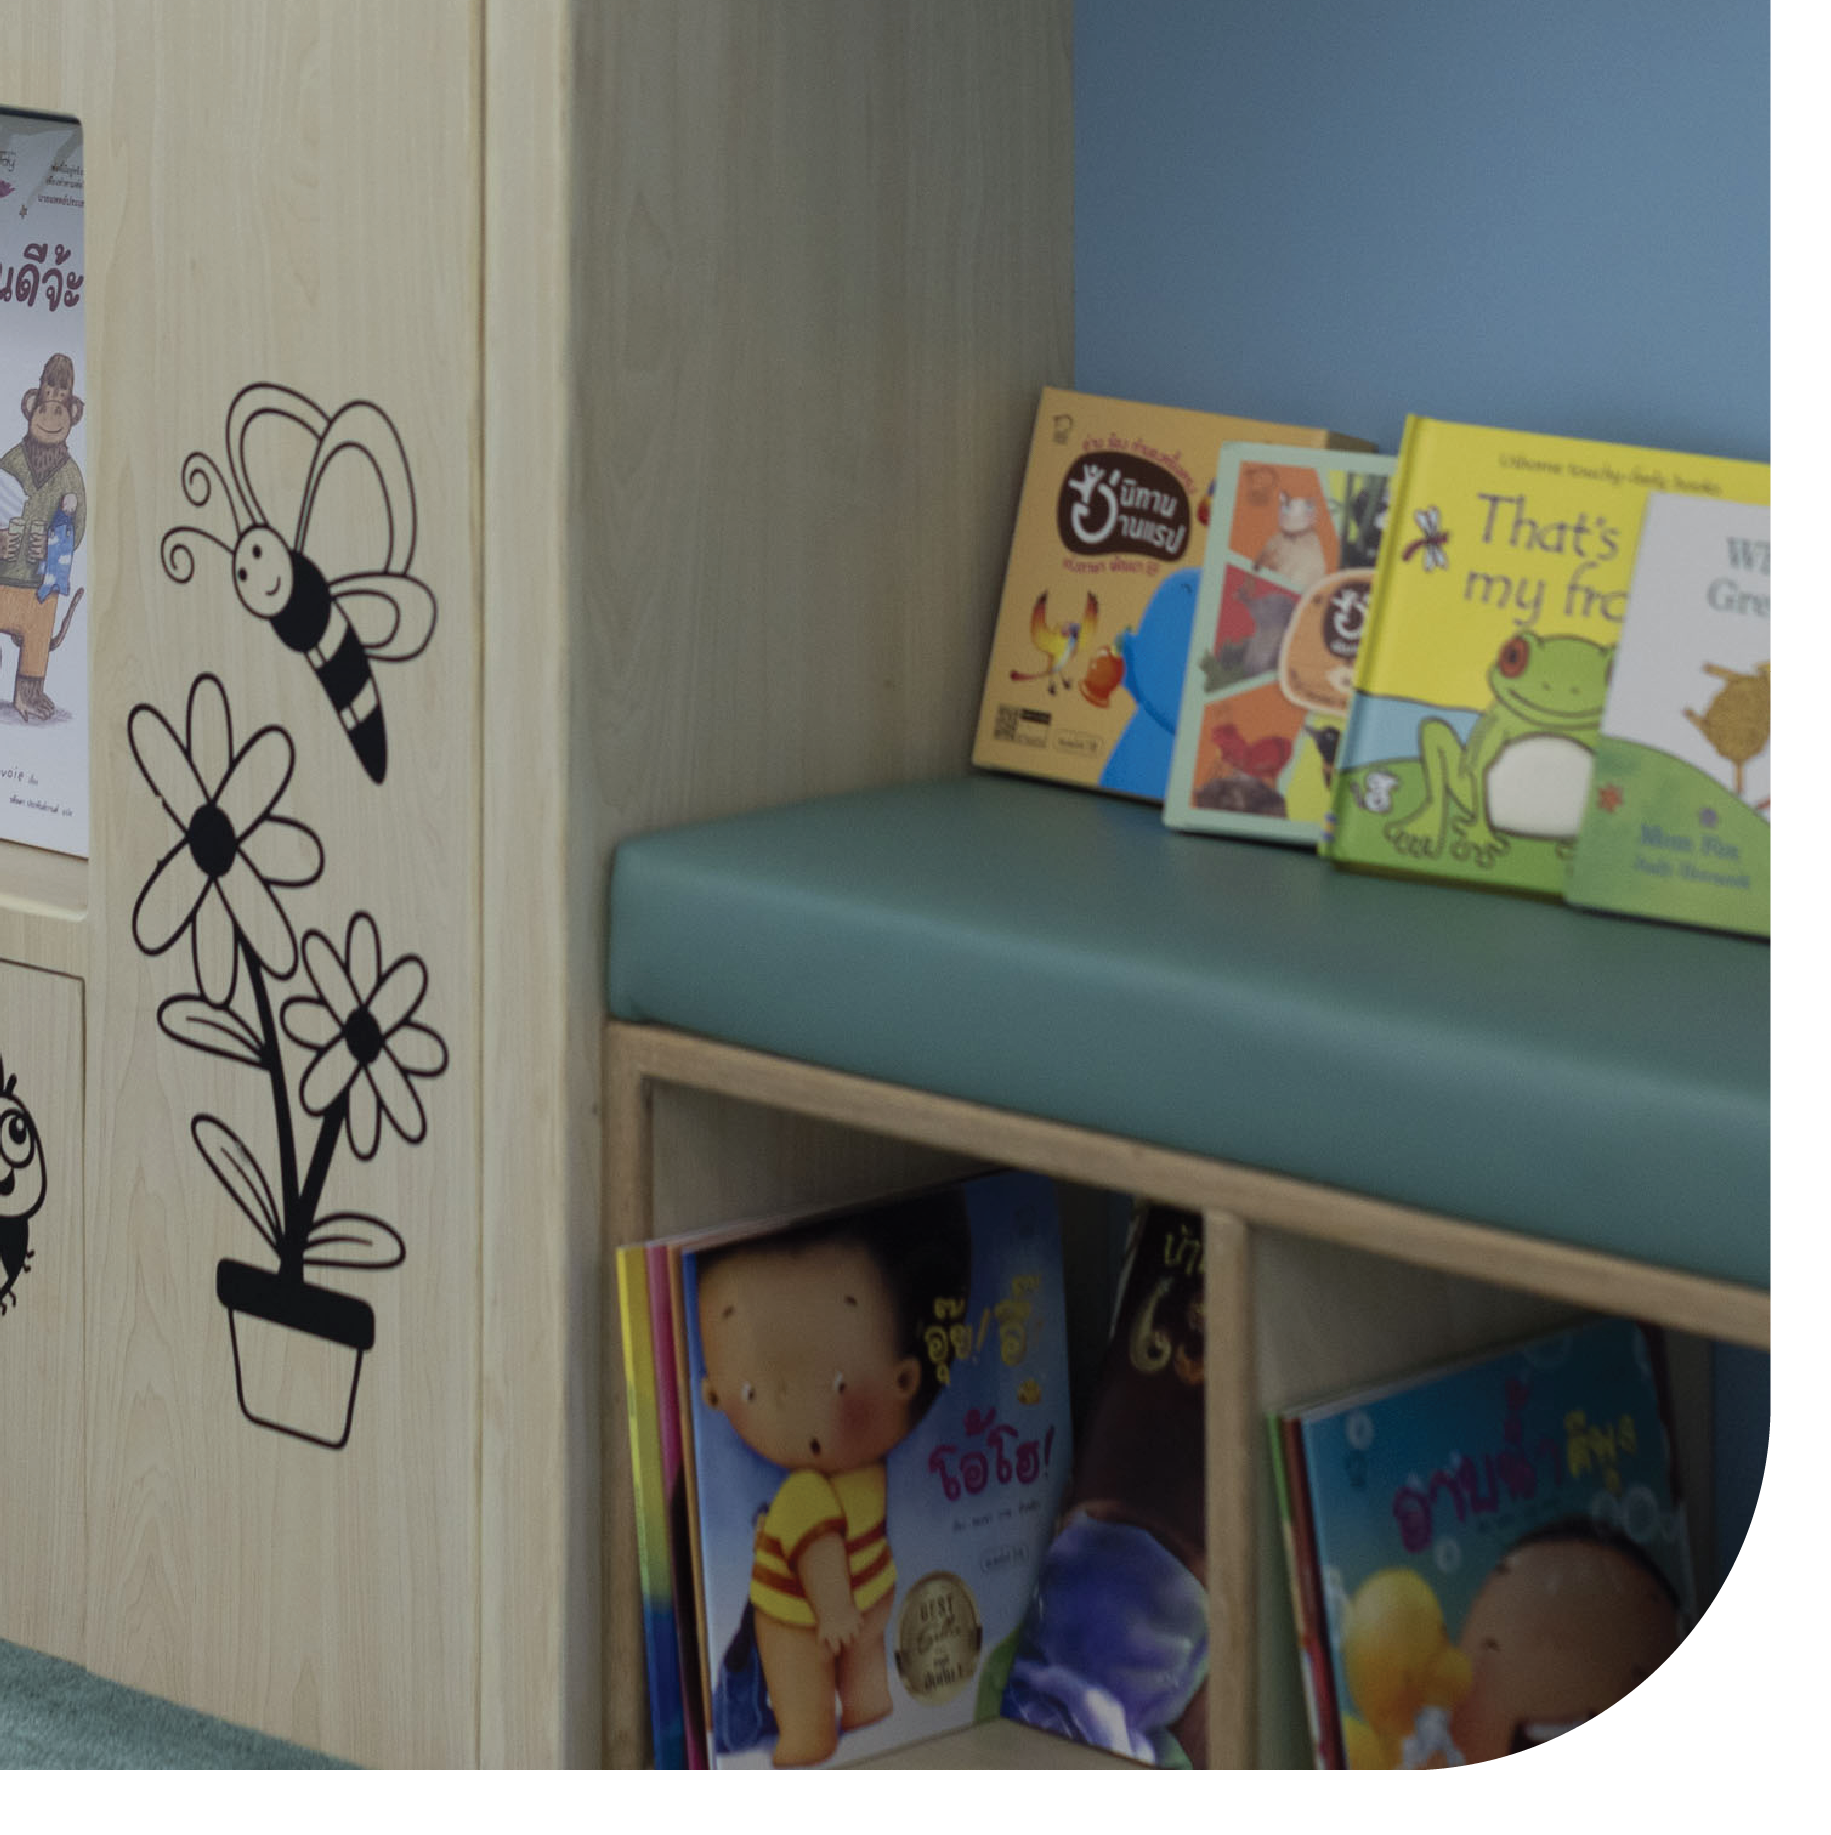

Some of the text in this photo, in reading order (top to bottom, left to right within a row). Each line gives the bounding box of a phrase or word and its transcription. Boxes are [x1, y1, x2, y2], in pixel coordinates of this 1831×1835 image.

[1477, 491, 1620, 563] That's
[1464, 570, 1546, 629] my
[927, 1406, 1055, 1503] โอ้โฮ!
